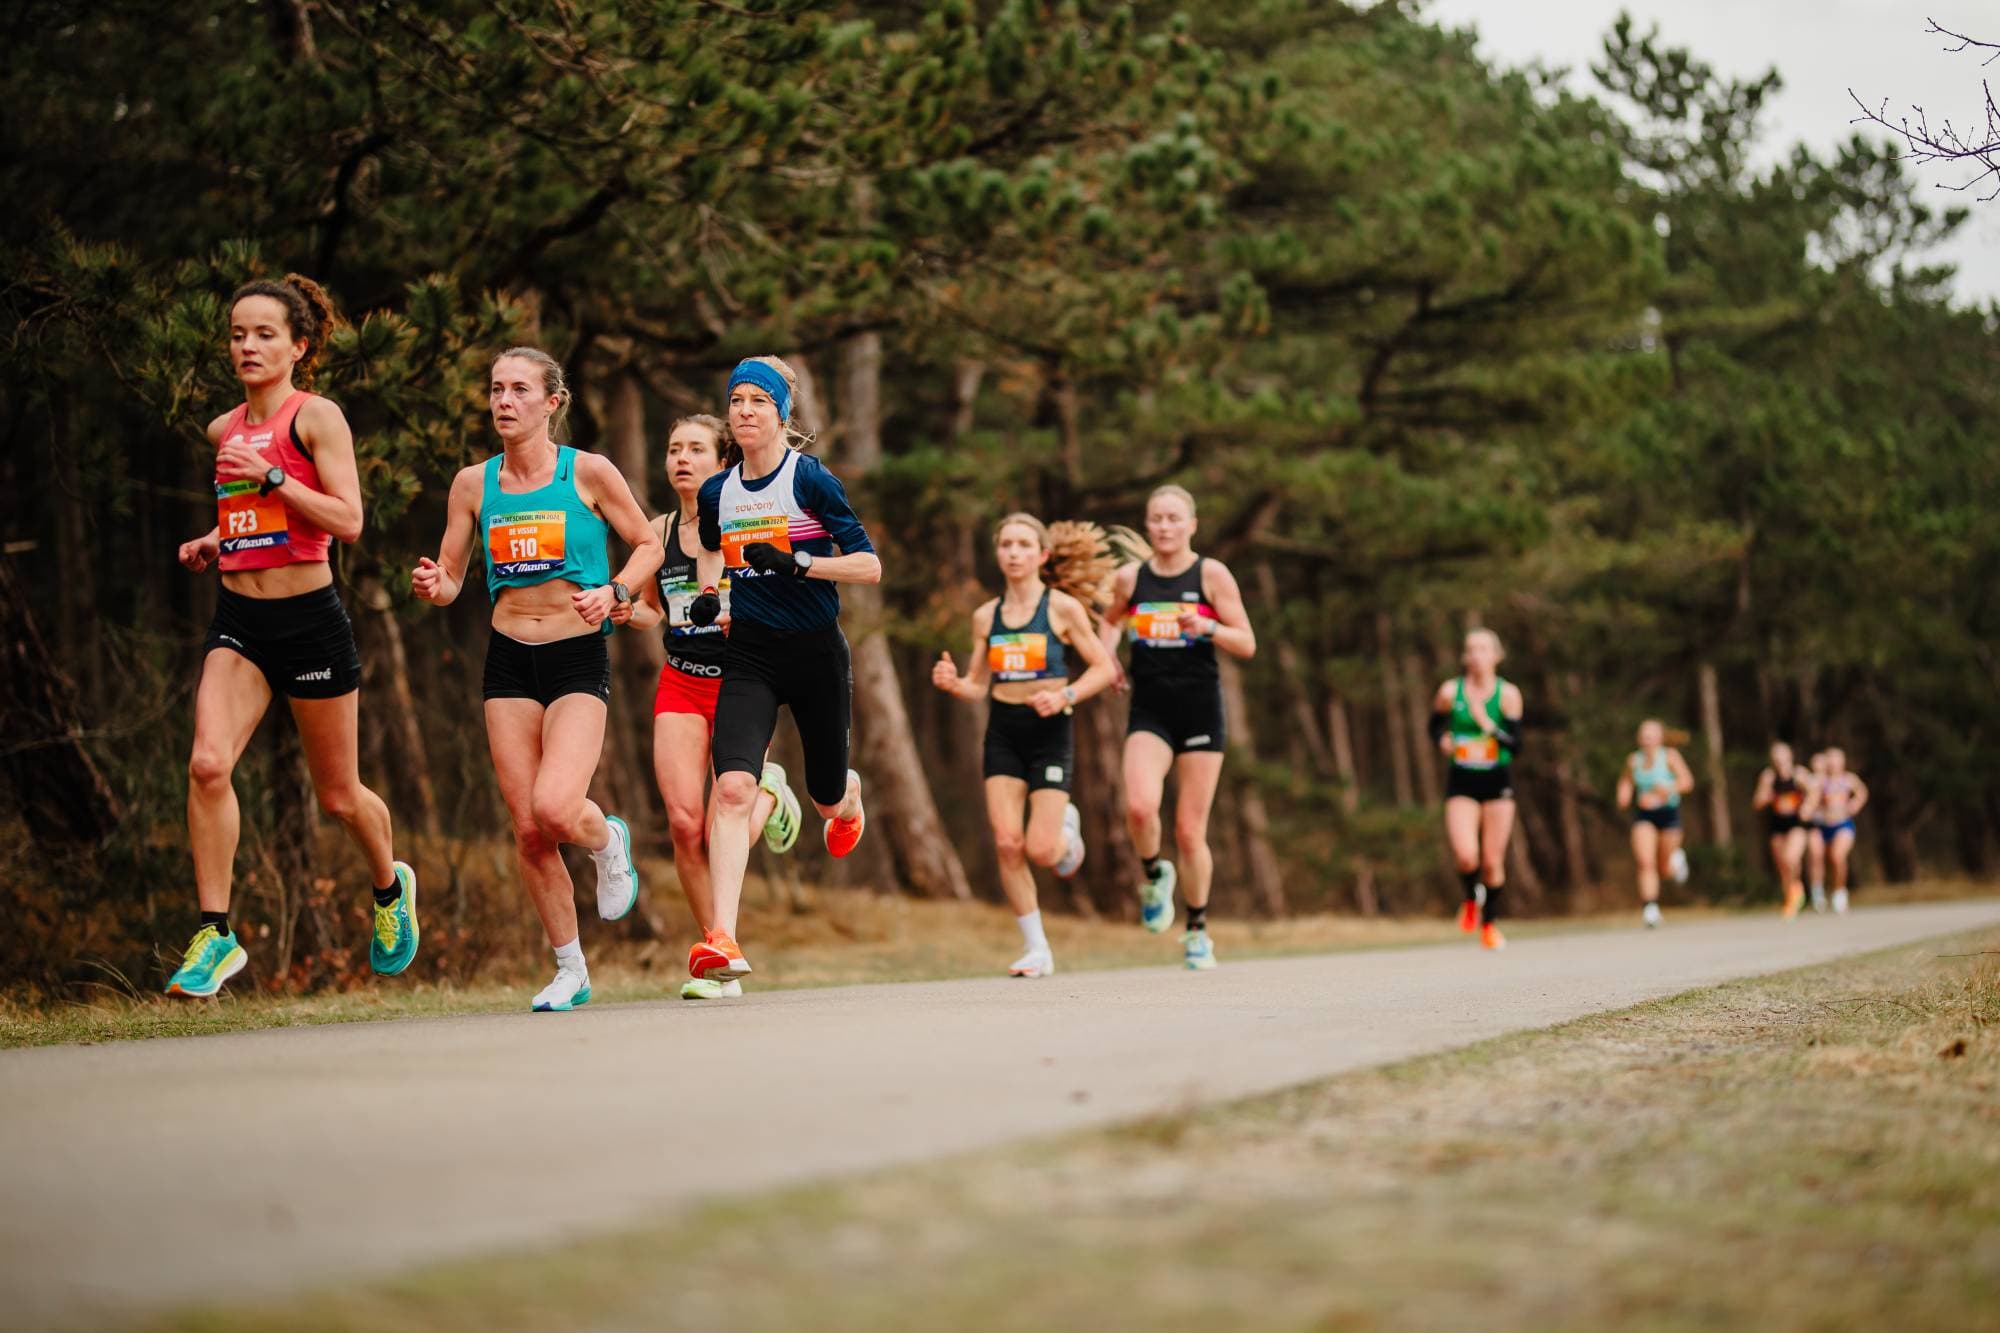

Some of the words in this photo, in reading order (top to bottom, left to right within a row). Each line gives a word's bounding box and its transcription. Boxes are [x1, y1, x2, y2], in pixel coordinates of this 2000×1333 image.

[735, 501, 774, 513] saucony
[228, 509, 257, 534] F23
[729, 533, 740, 542] VAN
[740, 532, 751, 541] DER
[510, 537, 537, 559] F10
[681, 660, 722, 677] PRO
